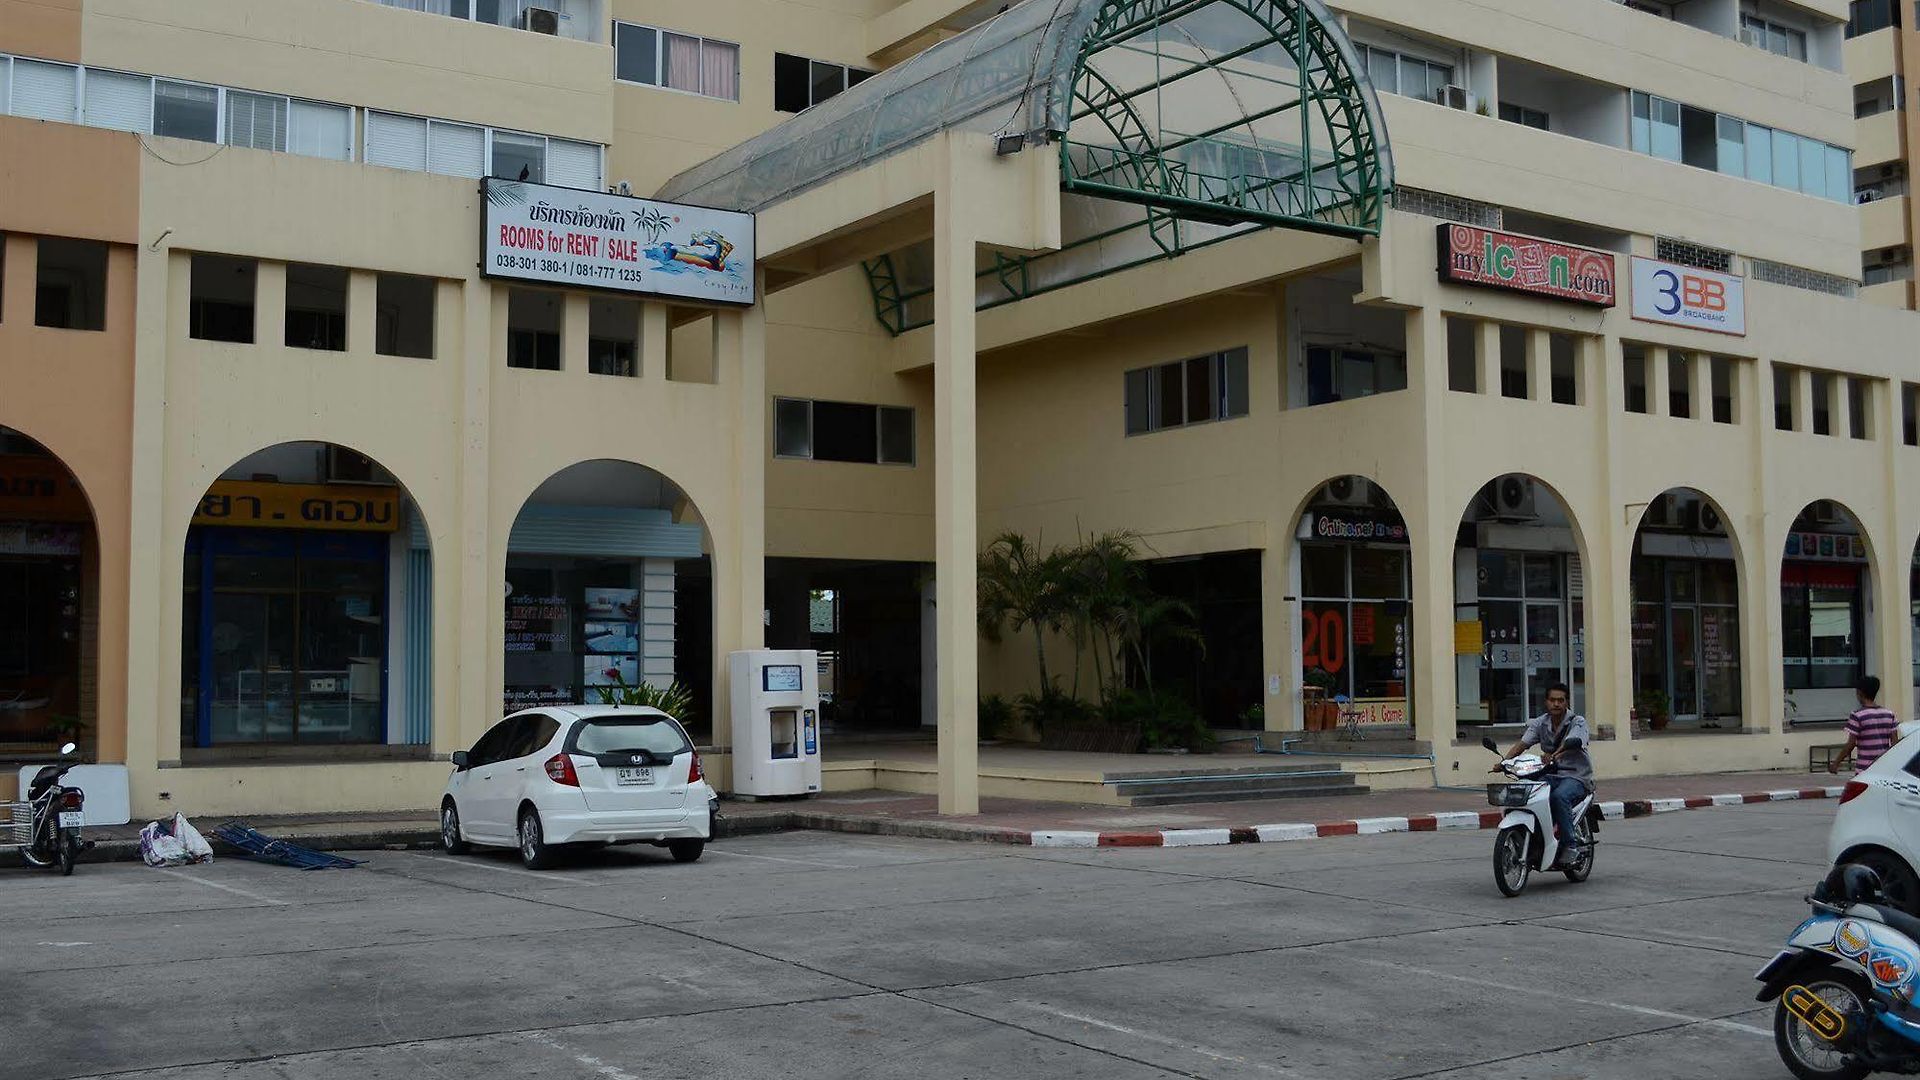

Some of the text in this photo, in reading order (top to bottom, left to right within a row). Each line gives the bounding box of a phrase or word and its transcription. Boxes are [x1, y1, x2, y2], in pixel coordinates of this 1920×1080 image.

[529, 200, 625, 232] บริการห้องพัก
[500, 224, 544, 251] ROOMS
[548, 230, 564, 253] for
[567, 233, 599, 257] RENT
[608, 238, 638, 262] SALE
[497, 254, 537, 271] 038-301
[540, 259, 567, 274] 380-1
[576, 263, 615, 279] 081-777
[618, 268, 642, 282] 1235
[1652, 269, 1726, 315] 3BB
[1683, 309, 1725, 322] BROADBAND
[1302, 608, 1344, 673] 20
